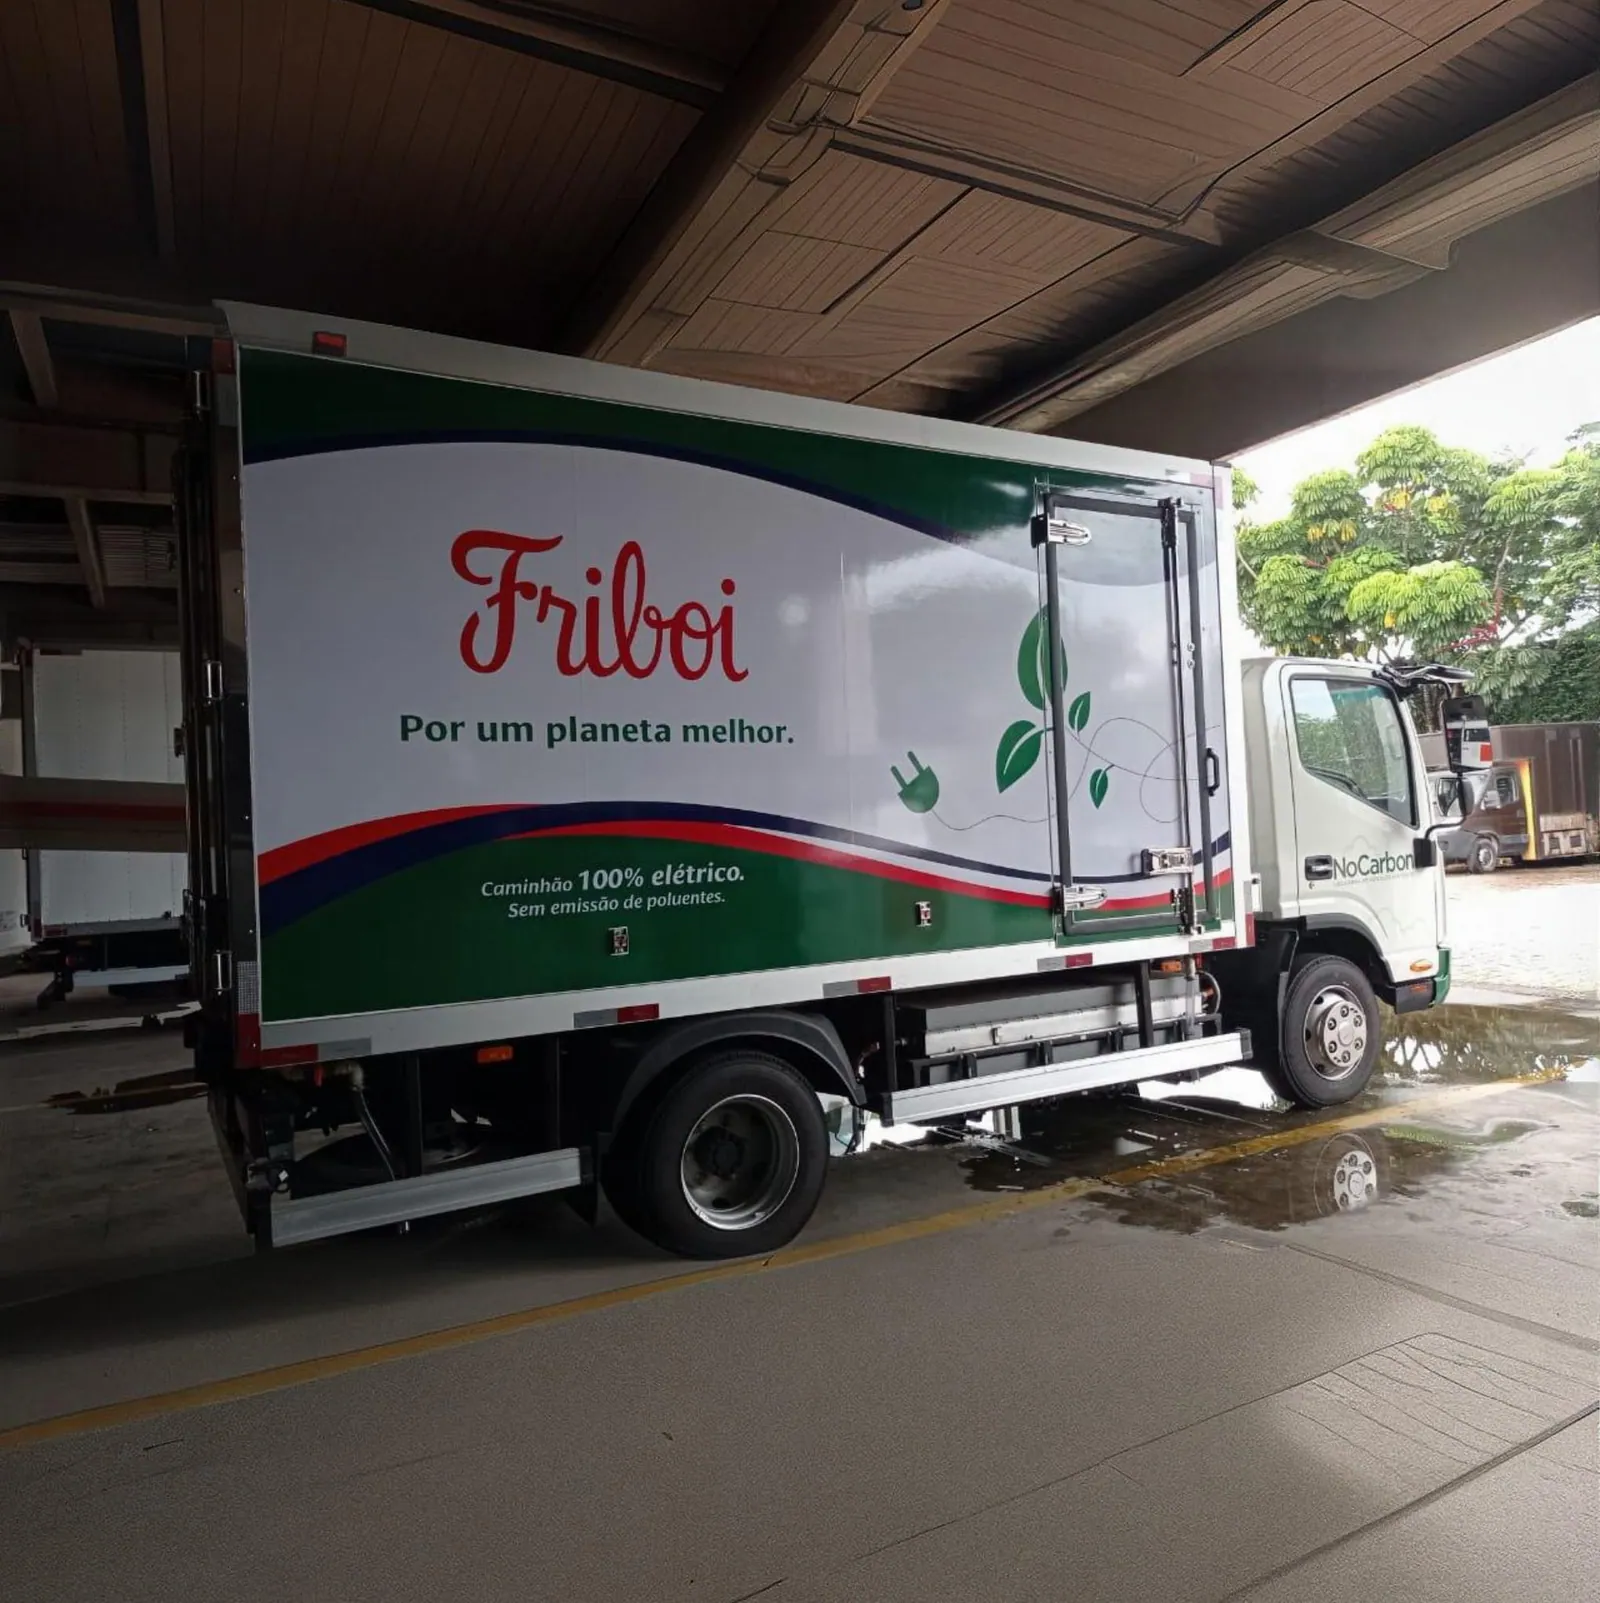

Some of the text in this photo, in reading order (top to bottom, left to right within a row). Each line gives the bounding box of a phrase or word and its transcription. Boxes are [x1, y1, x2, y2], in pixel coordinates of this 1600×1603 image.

[451, 530, 749, 682] Friboi
[400, 714, 795, 748] Por um planeta melhor.
[481, 862, 745, 897] Caminhão 100% elétrico.
[1333, 851, 1415, 880] NoCarbon
[508, 890, 726, 918] Sem emissão de poluentes.
